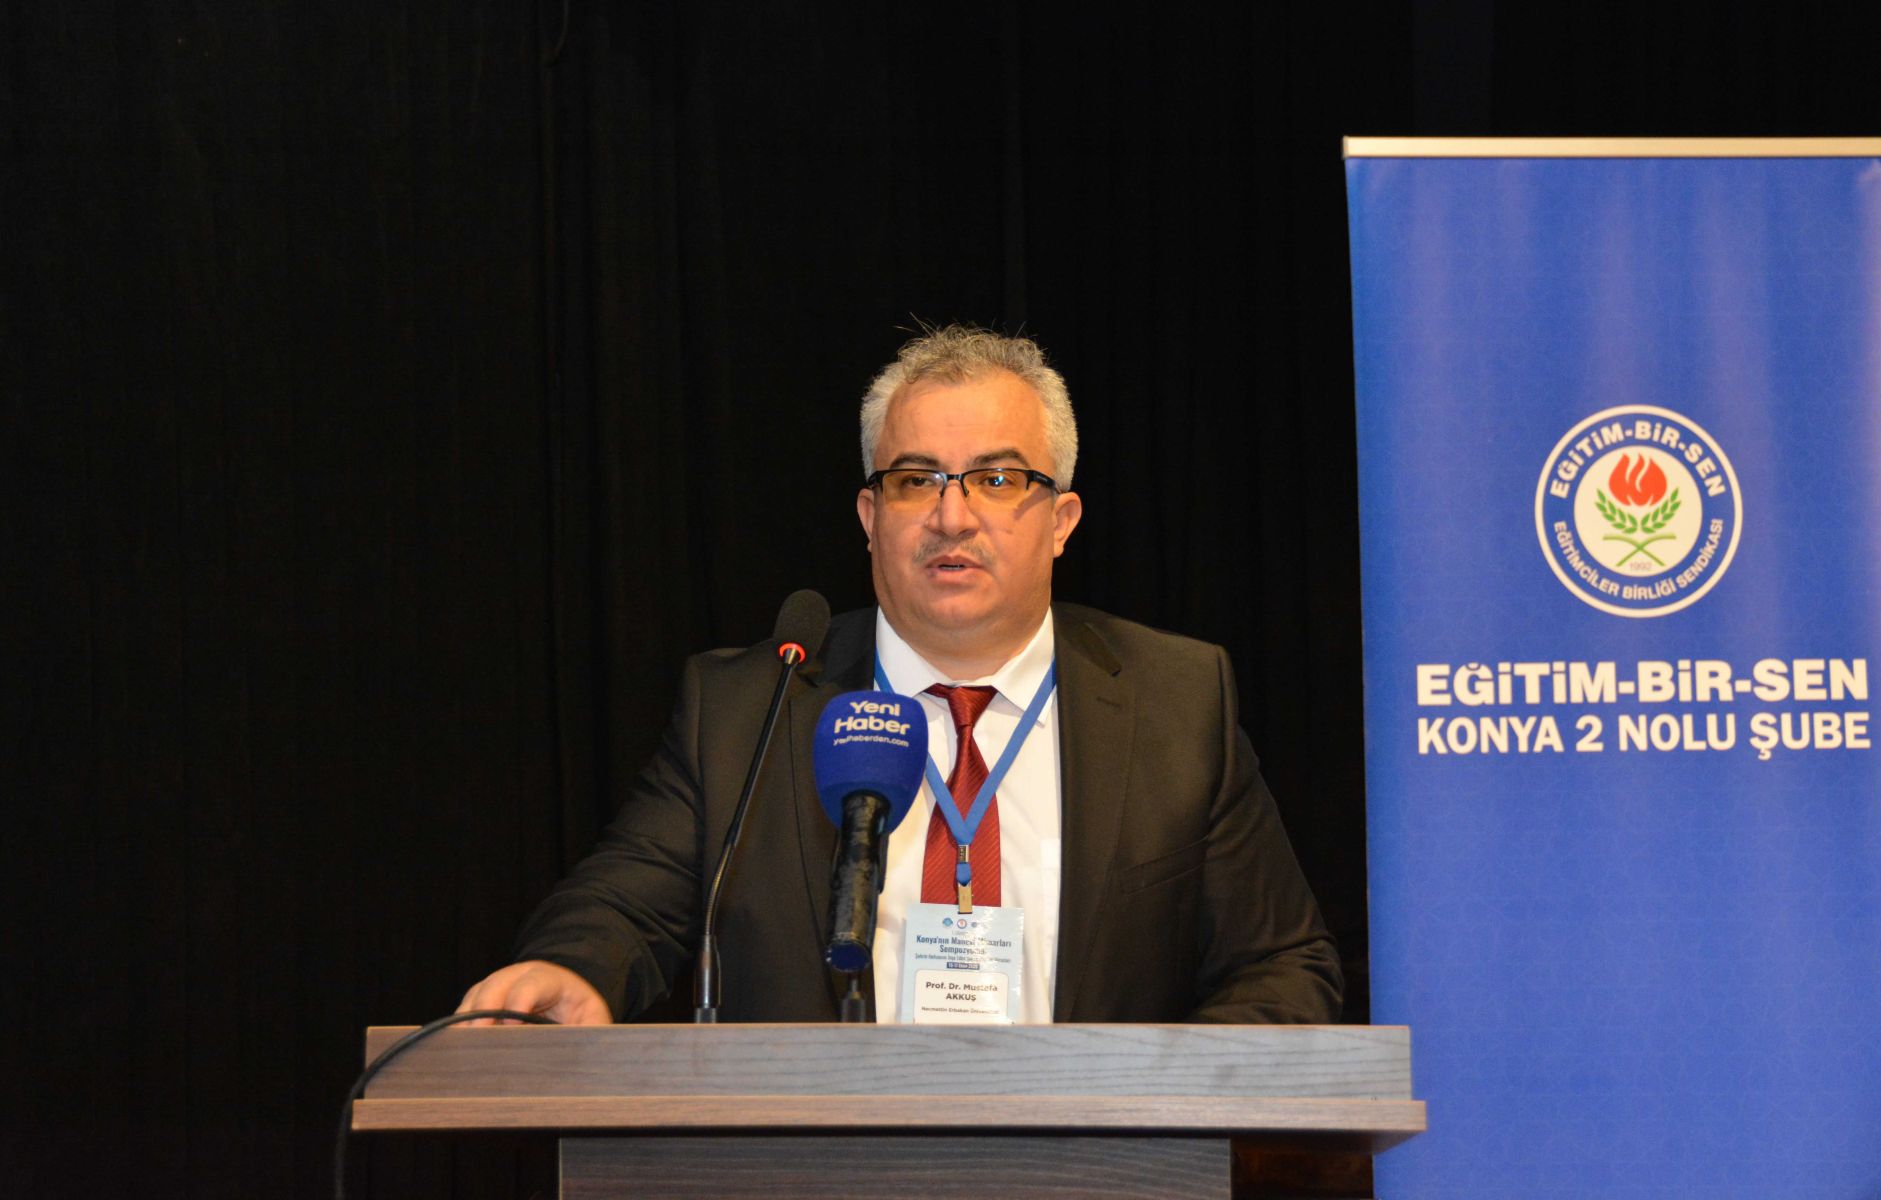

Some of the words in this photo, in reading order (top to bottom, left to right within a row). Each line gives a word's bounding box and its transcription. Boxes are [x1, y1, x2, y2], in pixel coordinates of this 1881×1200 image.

[1554, 520, 1619, 596] EĞİTİMCİLER
[1622, 578, 1676, 600] BİRLİĞİ
[1675, 518, 1724, 588] SENDİKASI
[850, 700, 900, 717] Yeni
[834, 715, 911, 735] Haber
[1418, 715, 1565, 755] KONYA
[1575, 714, 1604, 753] 2
[1618, 713, 1736, 752] NOLU
[1749, 711, 1871, 761] ŞUBE
[925, 981, 947, 990] Prof.
[948, 982, 962, 991] Dr.
